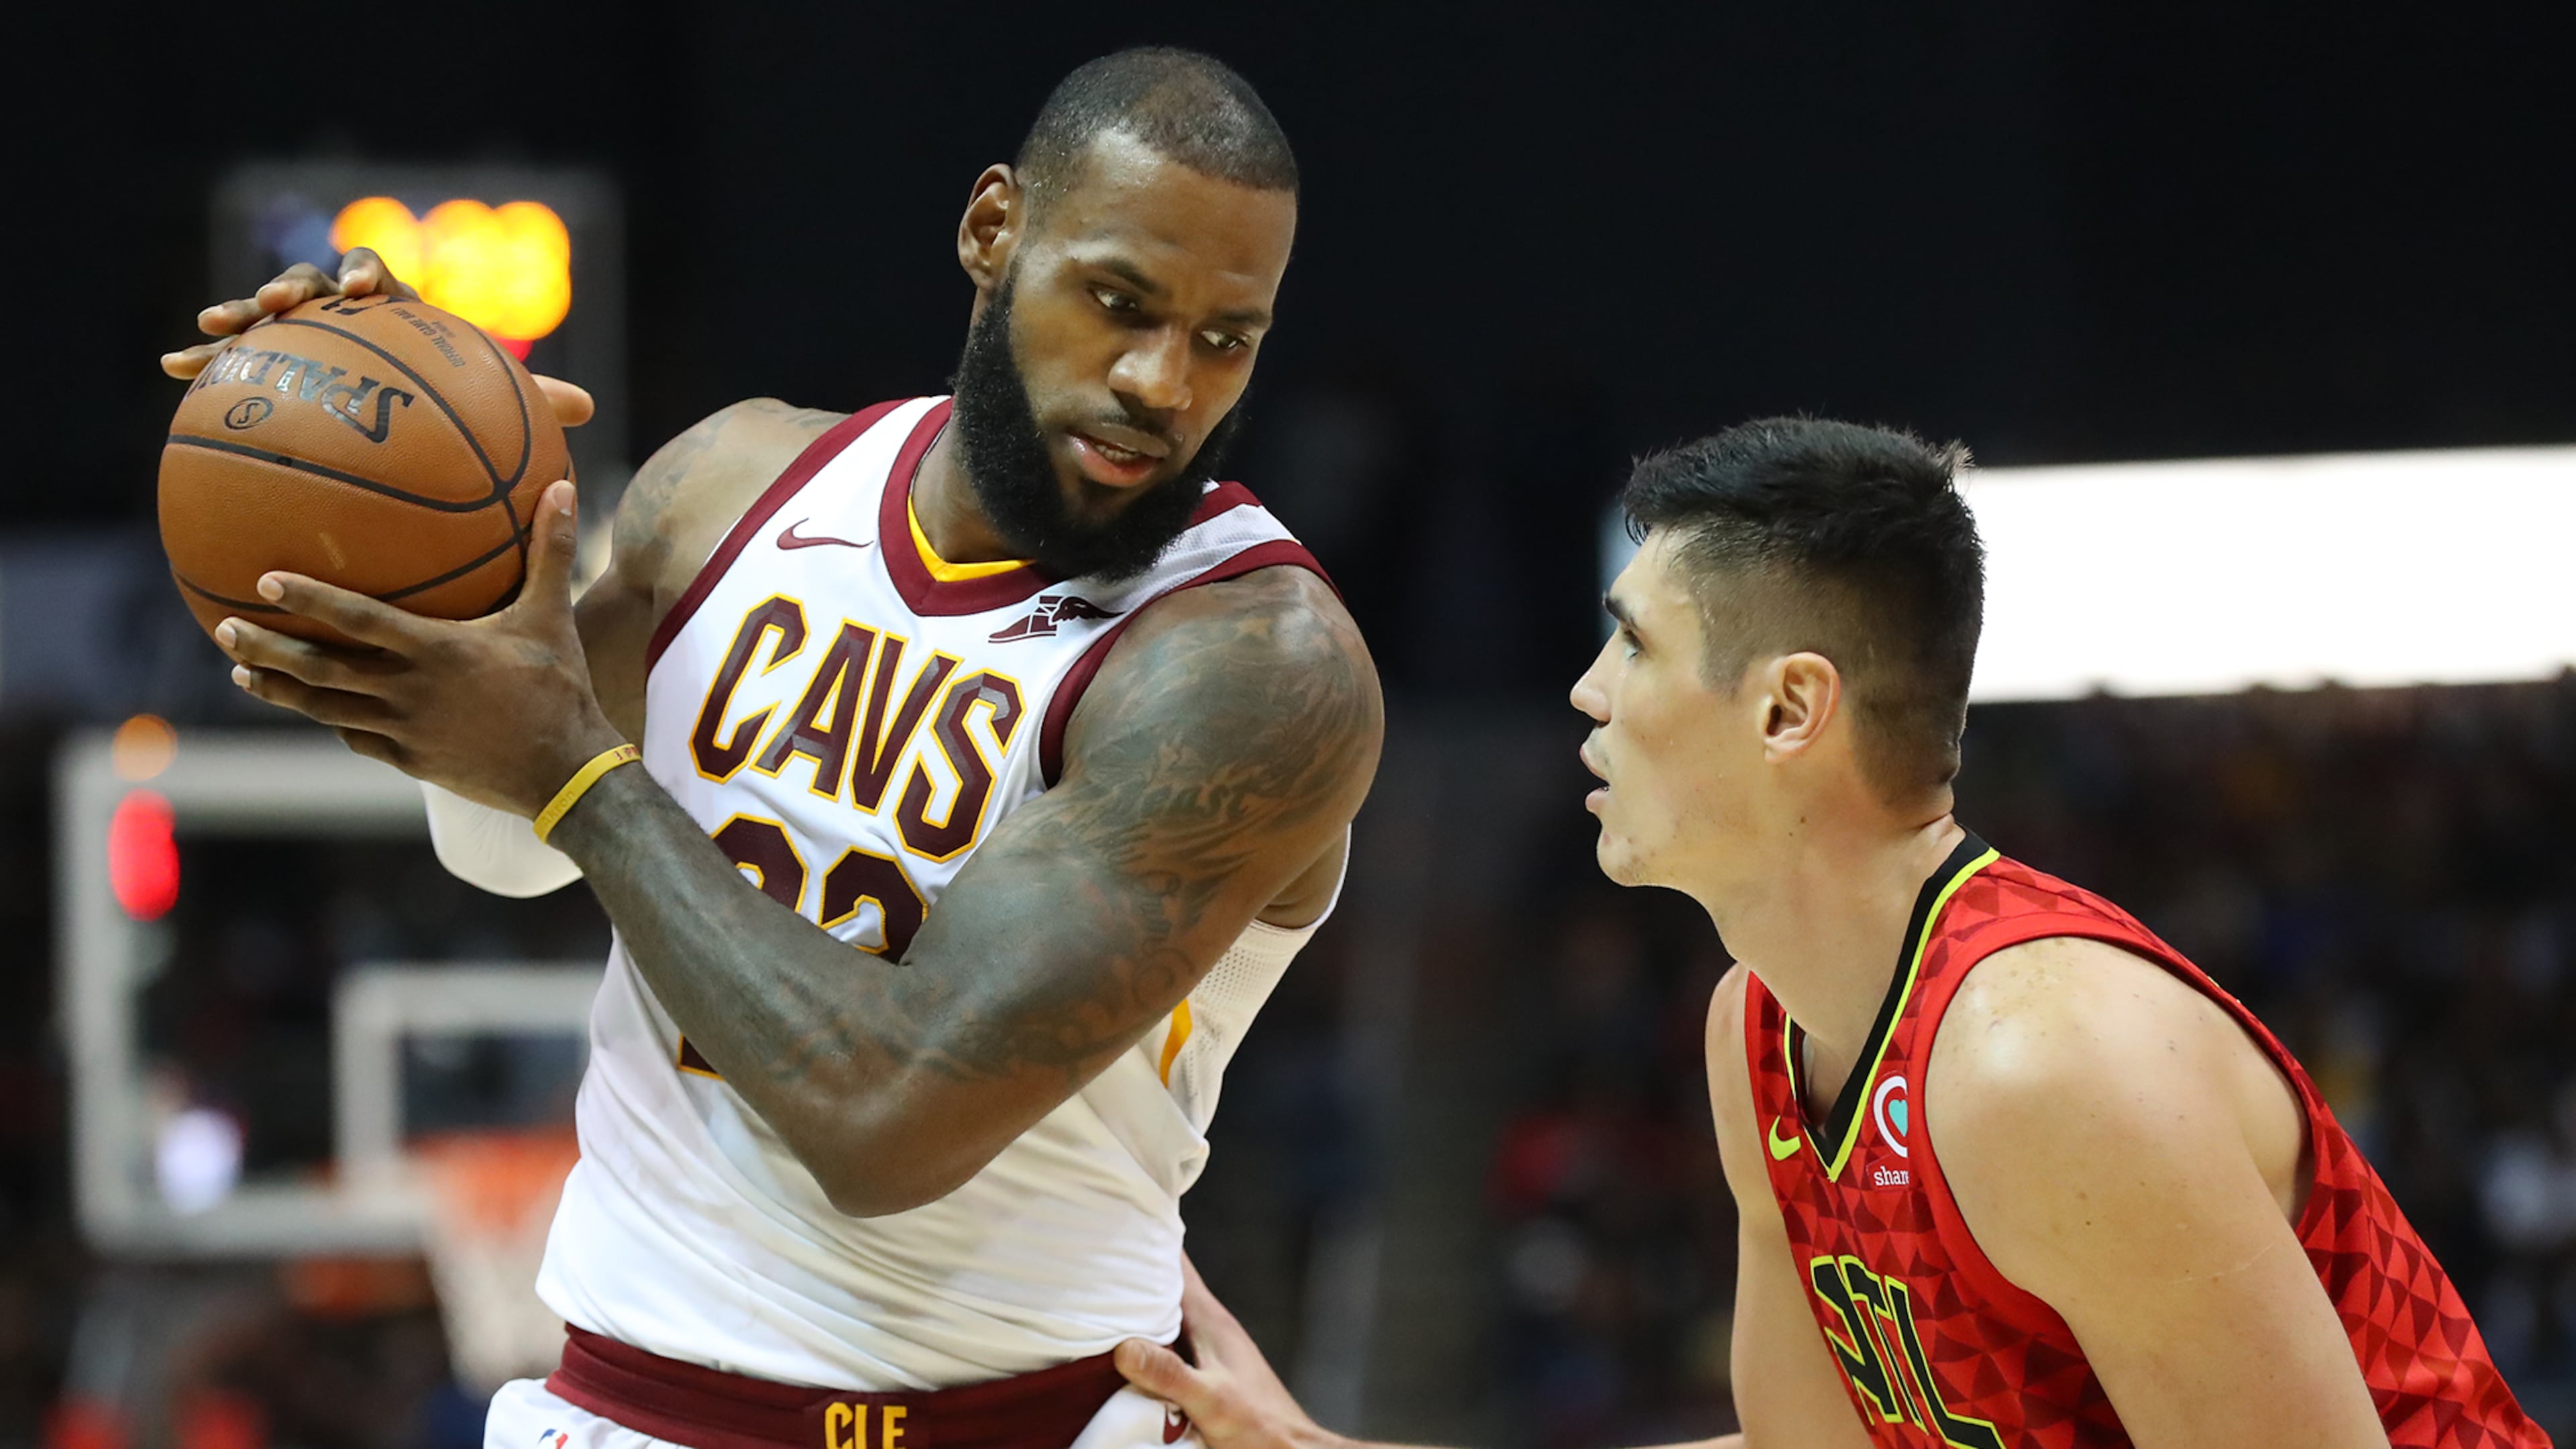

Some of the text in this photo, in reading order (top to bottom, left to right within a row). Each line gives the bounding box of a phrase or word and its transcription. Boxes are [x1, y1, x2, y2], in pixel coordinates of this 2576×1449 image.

[408, 319, 437, 335] GAME
[184, 347, 415, 443] SPALDIN
[688, 592, 1027, 863] CAVS
[825, 1401, 907, 1449] CLE
